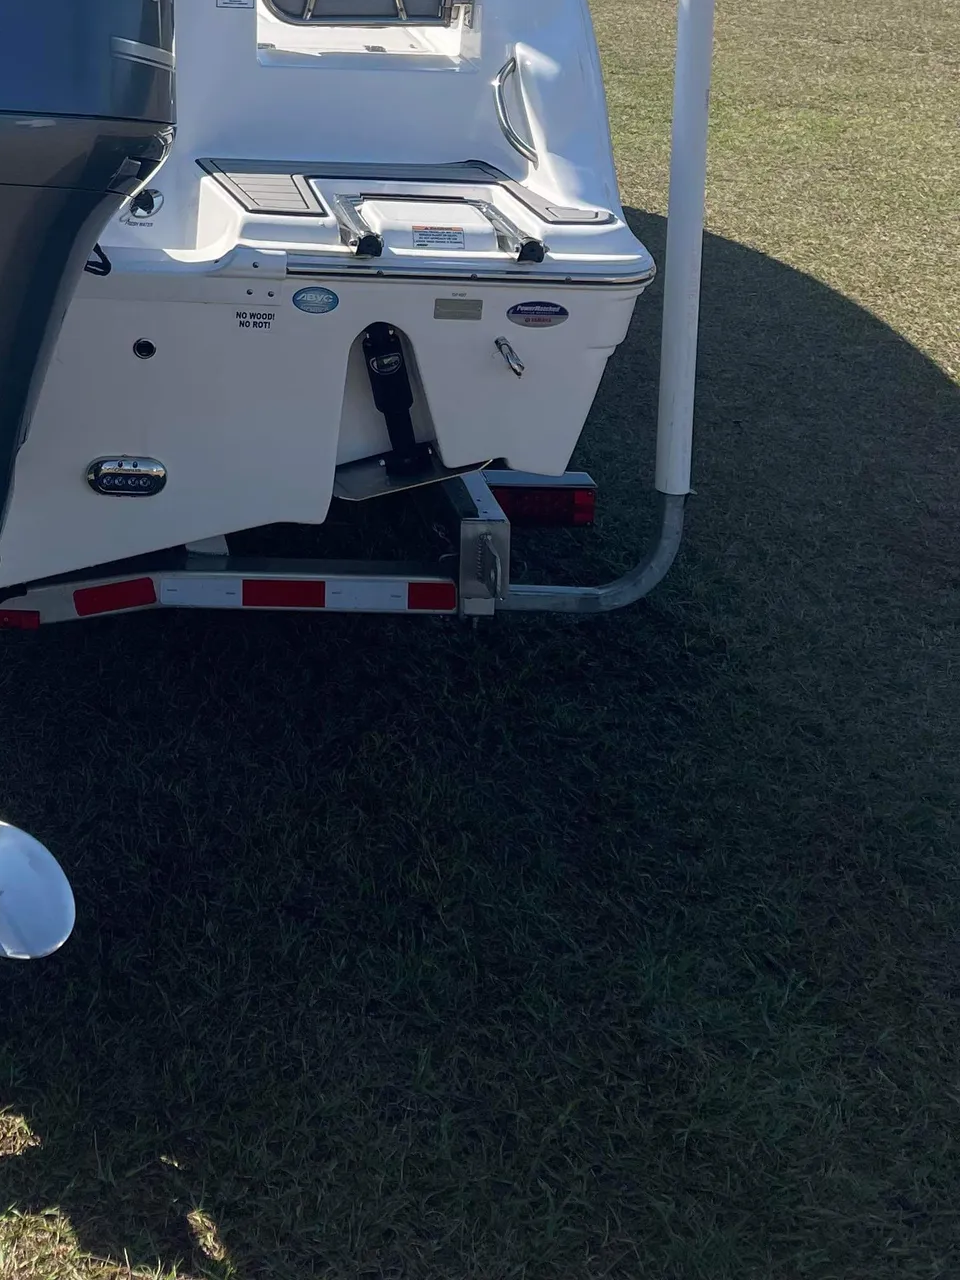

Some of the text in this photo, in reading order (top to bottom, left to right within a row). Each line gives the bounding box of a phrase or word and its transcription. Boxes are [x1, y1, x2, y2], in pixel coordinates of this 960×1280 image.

[235, 311, 275, 321] NO WOOD!
[252, 321, 271, 329] ROT!
